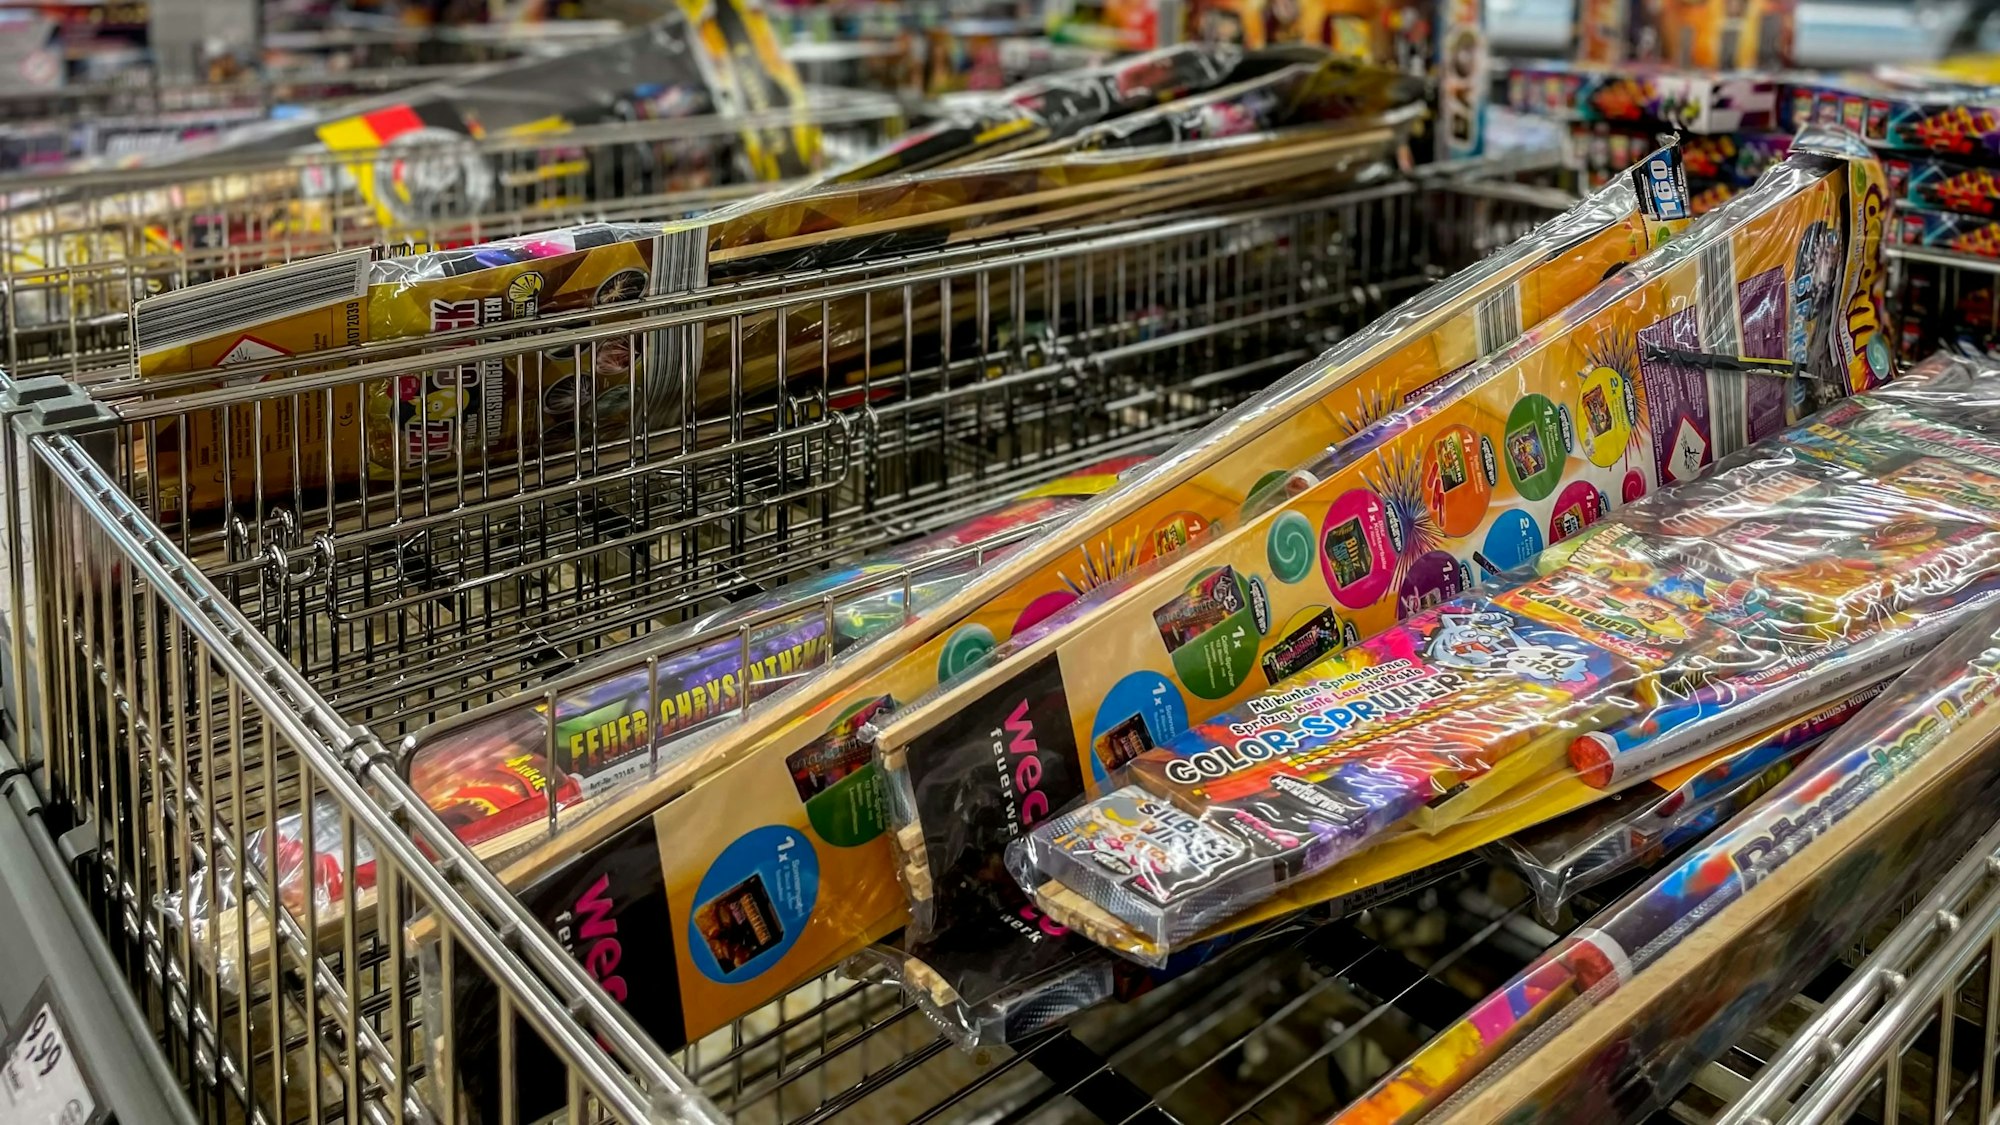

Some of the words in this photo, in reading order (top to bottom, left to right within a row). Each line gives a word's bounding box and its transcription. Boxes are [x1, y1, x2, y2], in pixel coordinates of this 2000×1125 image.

[1651, 159, 1677, 221] 160
[1544, 406, 1554, 425] 1x
[1462, 433, 1473, 454] 1x
[1367, 502, 1379, 522] 1x
[1586, 491, 1595, 509] 1x
[1520, 516, 1530, 537] 2x
[1442, 560, 1453, 581] 1x
[1232, 625, 1246, 649] 1x
[1749, 661, 1790, 685] Schuss
[1849, 627, 1876, 646] Licht
[1152, 681, 1167, 706] 1x
[1250, 697, 1271, 714] Mit
[1273, 685, 1320, 710] bunten
[1319, 656, 1412, 692] Sprühsternen
[1231, 710, 1296, 737] Spritzig,
[1295, 696, 1335, 717] bunte
[1333, 667, 1424, 703] Leuchteffekte
[568, 708, 649, 777] FEUER
[1004, 697, 1050, 831] wec
[989, 726, 1019, 838] feuerwe
[777, 835, 795, 862] 1x
[574, 872, 628, 1003] wec
